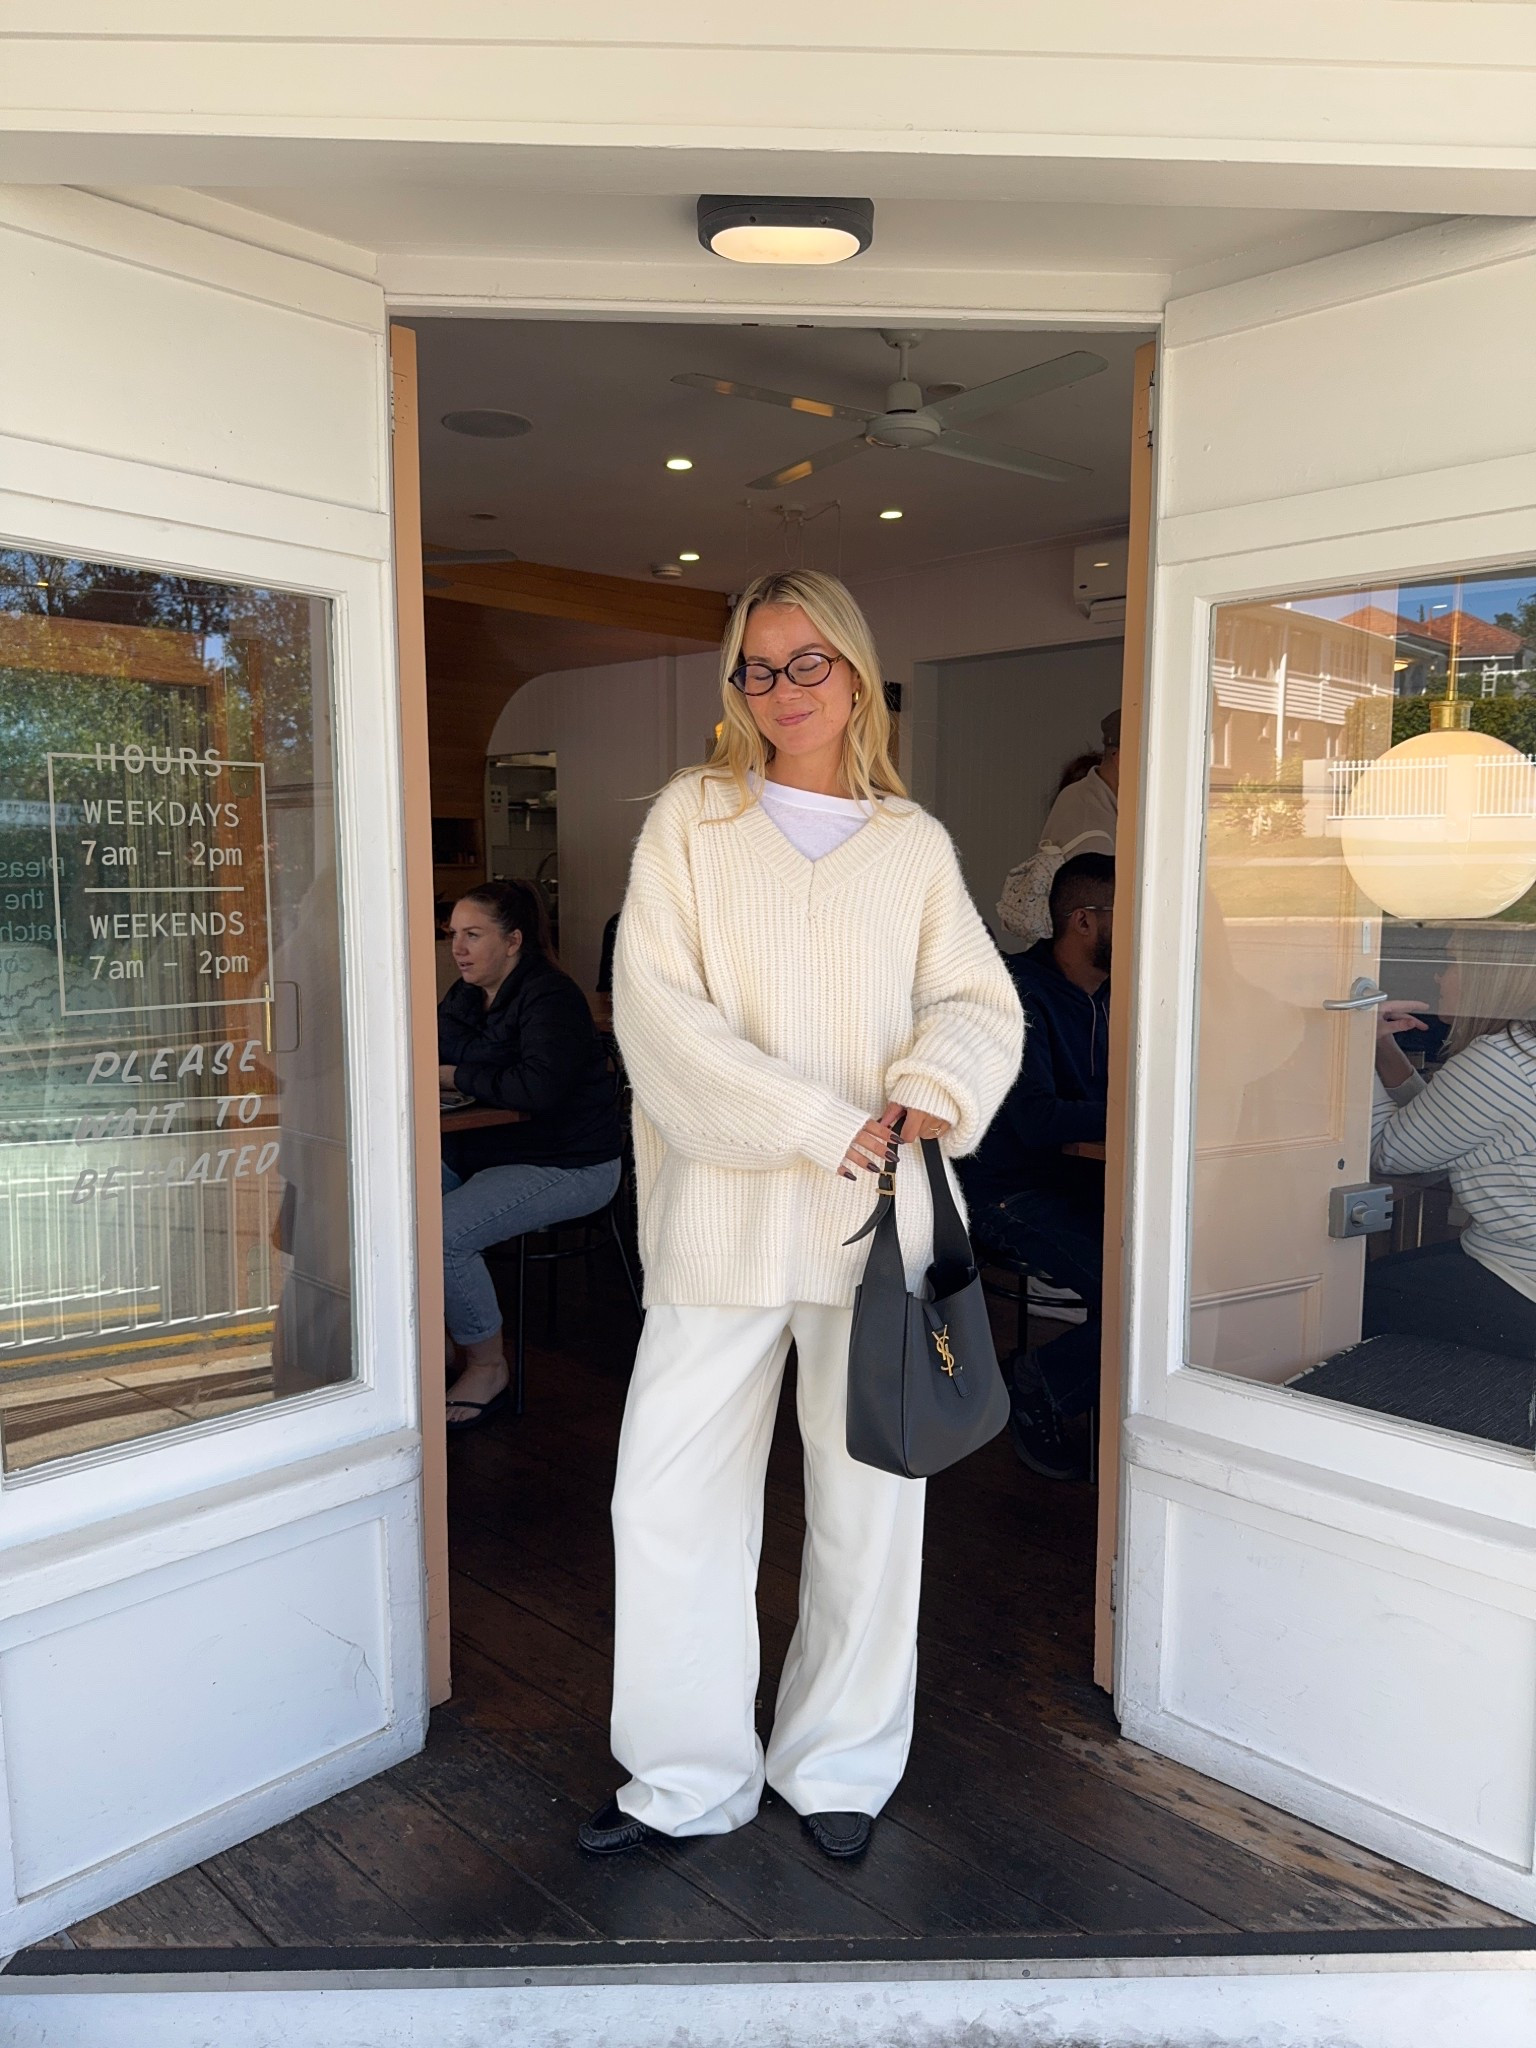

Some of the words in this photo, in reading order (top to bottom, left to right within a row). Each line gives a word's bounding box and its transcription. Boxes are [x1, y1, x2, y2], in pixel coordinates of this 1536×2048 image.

[95, 743, 222, 777] HOURS
[83, 799, 240, 827] WEEKDAYS
[81, 840, 138, 866] 7am
[191, 841, 243, 871] 2pm
[90, 911, 245, 939] WEEKENDS
[89, 955, 144, 980] 7am
[199, 950, 249, 979] 2pm
[86, 1039, 262, 1087] PLEASE
[74, 1101, 186, 1147] WAIT
[216, 1092, 262, 1128] TO
[70, 1165, 127, 1205] BE
